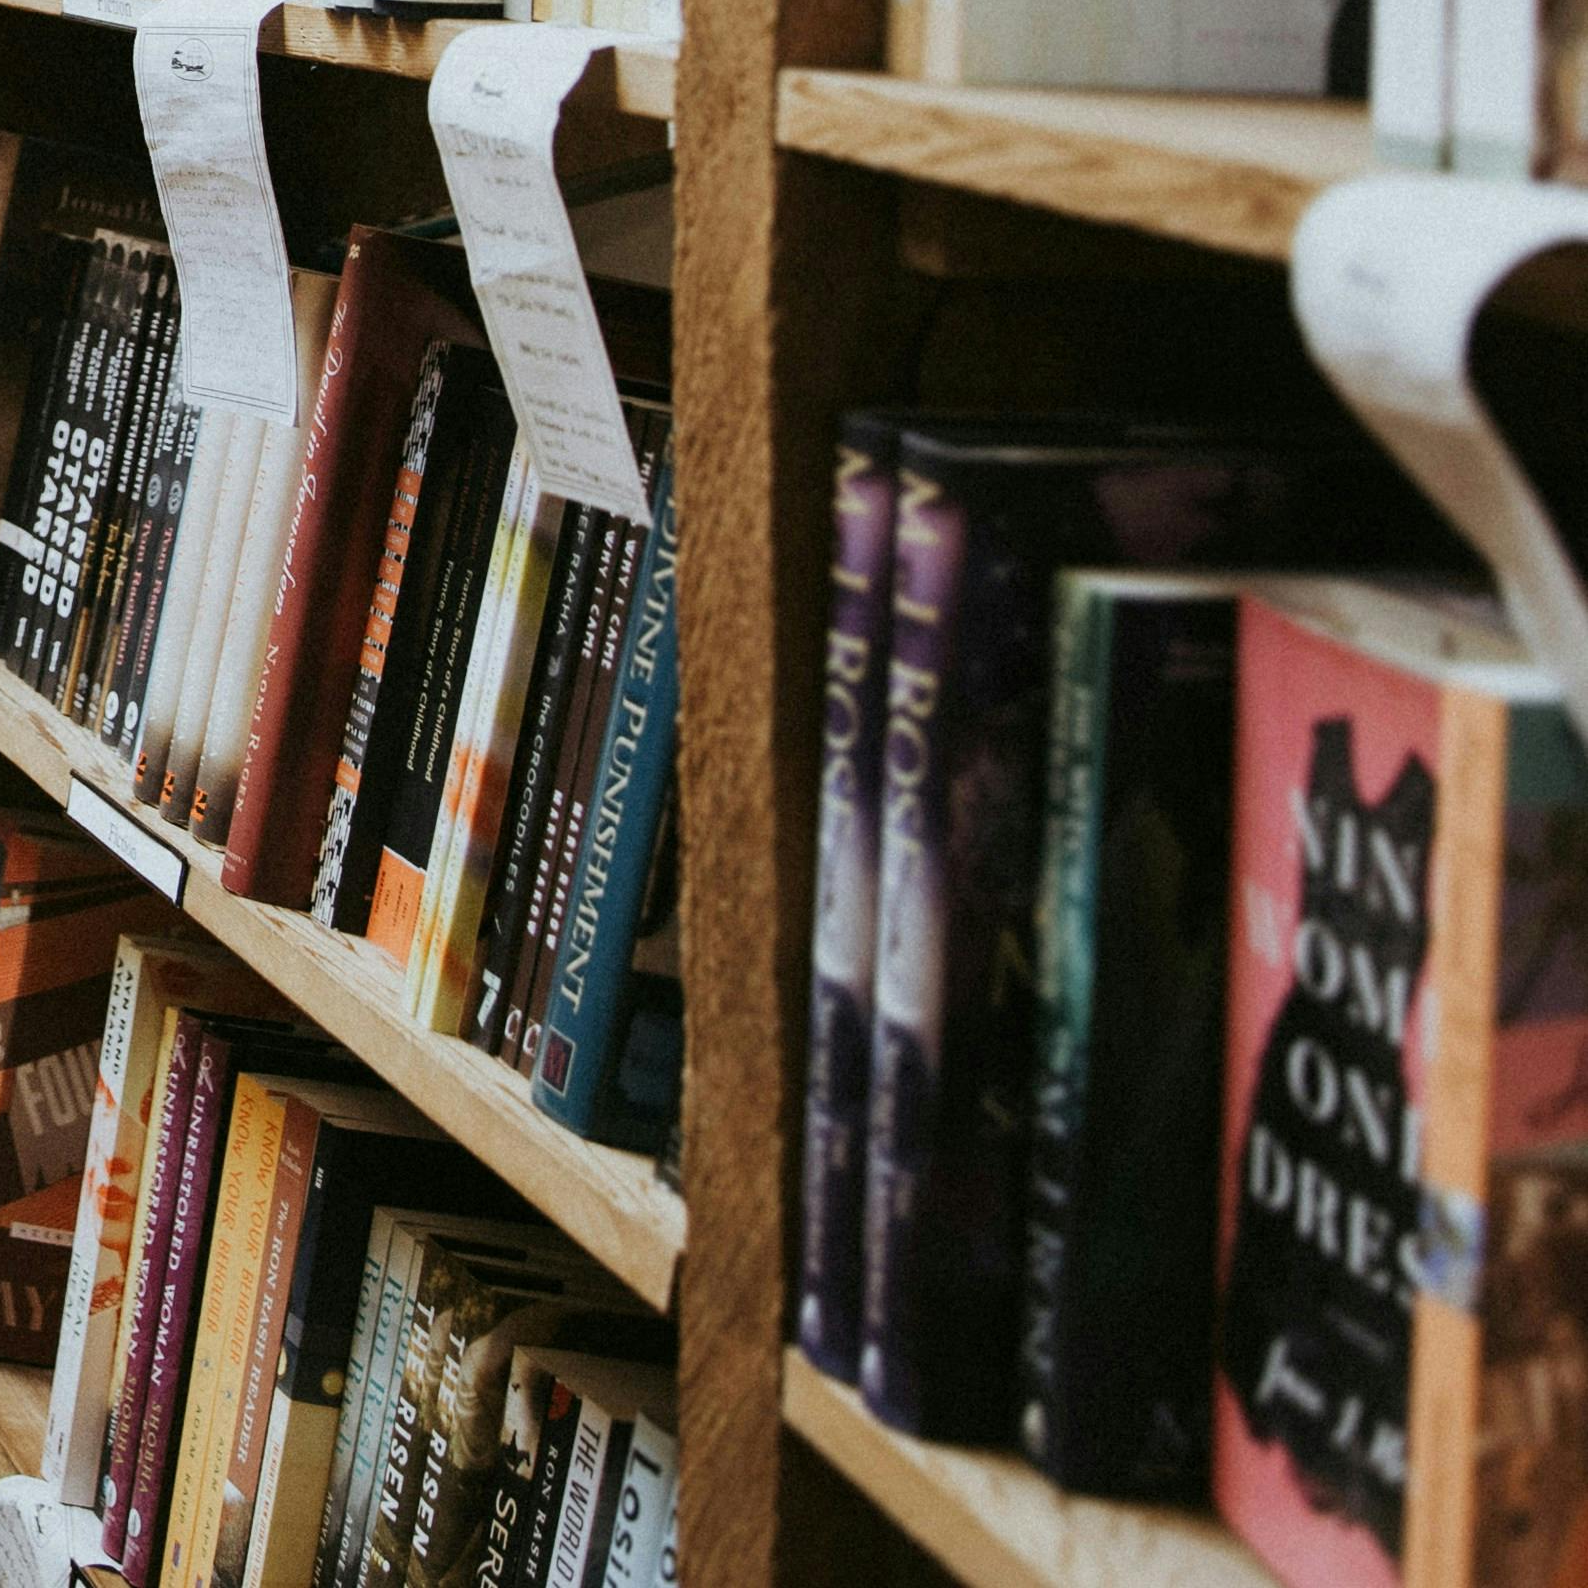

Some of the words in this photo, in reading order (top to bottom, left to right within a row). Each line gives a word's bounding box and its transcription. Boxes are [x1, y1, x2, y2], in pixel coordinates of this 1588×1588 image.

[131, 307, 142, 333] THE
[150, 311, 161, 339] THE
[164, 318, 174, 346] THE
[331, 301, 347, 337] The
[117, 345, 155, 494] IMPERFECTIONISTS
[313, 346, 343, 437] Devil
[306, 430, 320, 460] in
[22, 419, 71, 596] OTARED
[39, 427, 88, 606] OTARED
[56, 436, 105, 619] OTARED
[274, 463, 317, 616] Jerusalem
[158, 526, 174, 572] Tom
[436, 560, 454, 613] France,
[597, 529, 615, 579] WHY
[617, 539, 636, 590] WHY
[116, 570, 143, 666] Rachman
[136, 578, 163, 677] Rachman
[453, 569, 472, 623] France,
[556, 552, 581, 637] RAKHA
[594, 585, 604, 594] I
[614, 595, 624, 605] I
[426, 617, 444, 658] Story
[446, 626, 462, 668] Story
[581, 603, 601, 660] CAME
[600, 616, 621, 671] CAME
[253, 643, 280, 722] NAOMI
[422, 659, 433, 682] of
[441, 670, 452, 692] of
[407, 691, 429, 772] Childhood
[425, 702, 447, 783] Childhood
[537, 695, 551, 727] the
[234, 732, 261, 813] RAGEN
[108, 821, 139, 863] Fiction
[505, 734, 544, 894] CROCODILES
[544, 789, 563, 851] MARY
[564, 801, 583, 864] MARY
[560, 696, 648, 1015] PUNISHMENT
[122, 969, 135, 1010] AYN
[143, 1071, 178, 1247] UNRESTORED
[232, 1092, 256, 1161] KNOW
[255, 1119, 279, 1190] KNOW
[168, 1093, 206, 1271] UNRESTORED
[221, 1171, 242, 1232] YOUR
[277, 1199, 290, 1233] The
[247, 1199, 266, 1261] YOUR
[265, 1234, 283, 1291] RON
[126, 1257, 151, 1359] WOMAN
[206, 1237, 232, 1335] BEHOLDER
[230, 1267, 254, 1366] BEHOLDER
[353, 1254, 381, 1337] Ron
[374, 1275, 403, 1358] Ron
[150, 1283, 176, 1386] WOMAN
[255, 1296, 273, 1362] RASH
[404, 1300, 435, 1383] THE
[334, 1355, 364, 1456] Rash
[436, 1331, 466, 1416] THE
[113, 1375, 137, 1465] SHOBHA
[139, 1403, 161, 1494] SHOBHA
[237, 1364, 262, 1465] READER
[354, 1375, 386, 1479] Rash
[573, 1422, 602, 1481] THE
[379, 1395, 416, 1522] RISEN
[411, 1428, 448, 1558] RISEN
[540, 1444, 559, 1501] RON
[526, 1507, 548, 1580] RASH
[554, 1479, 591, 1583] WORLD
